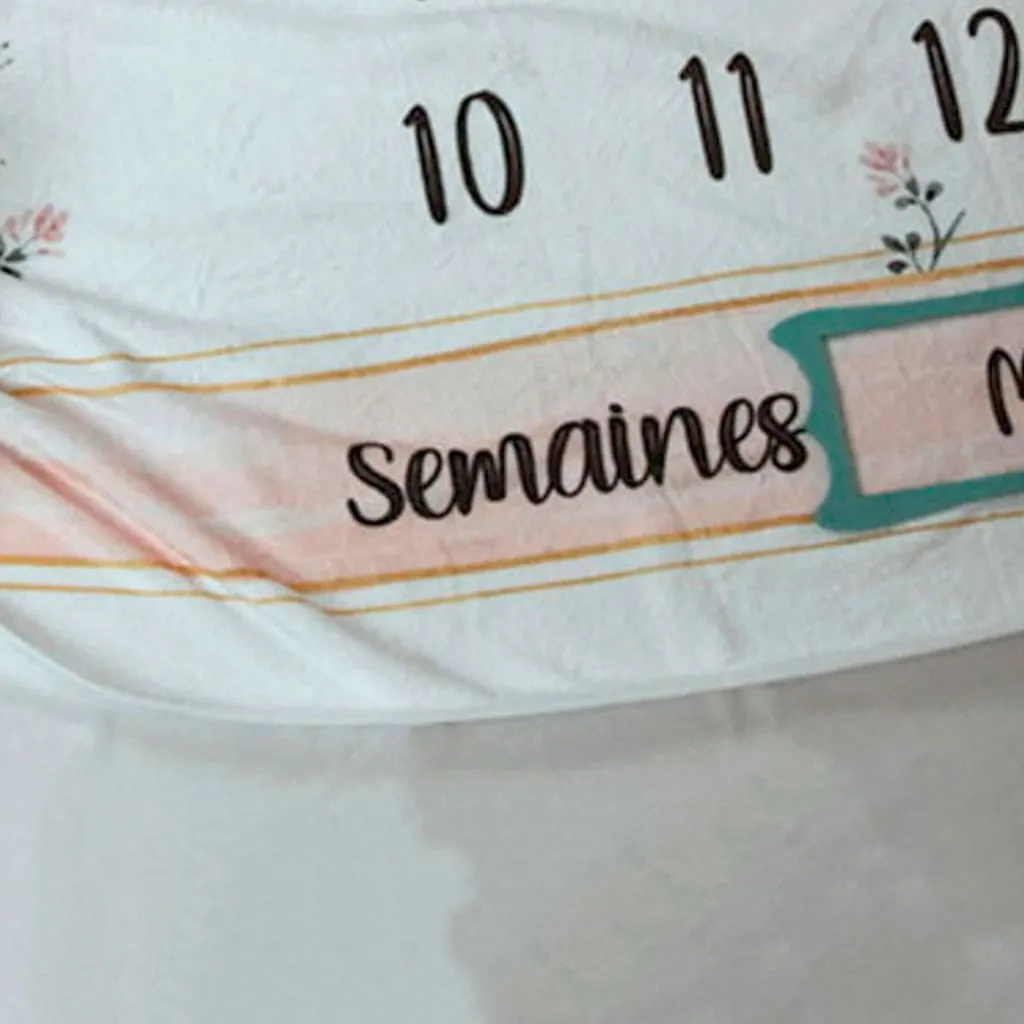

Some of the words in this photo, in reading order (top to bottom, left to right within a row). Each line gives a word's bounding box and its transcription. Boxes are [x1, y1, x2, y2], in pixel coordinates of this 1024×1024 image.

[403, 90, 525, 225] 10
[679, 52, 773, 181] 11
[912, 8, 1024, 143] 12
